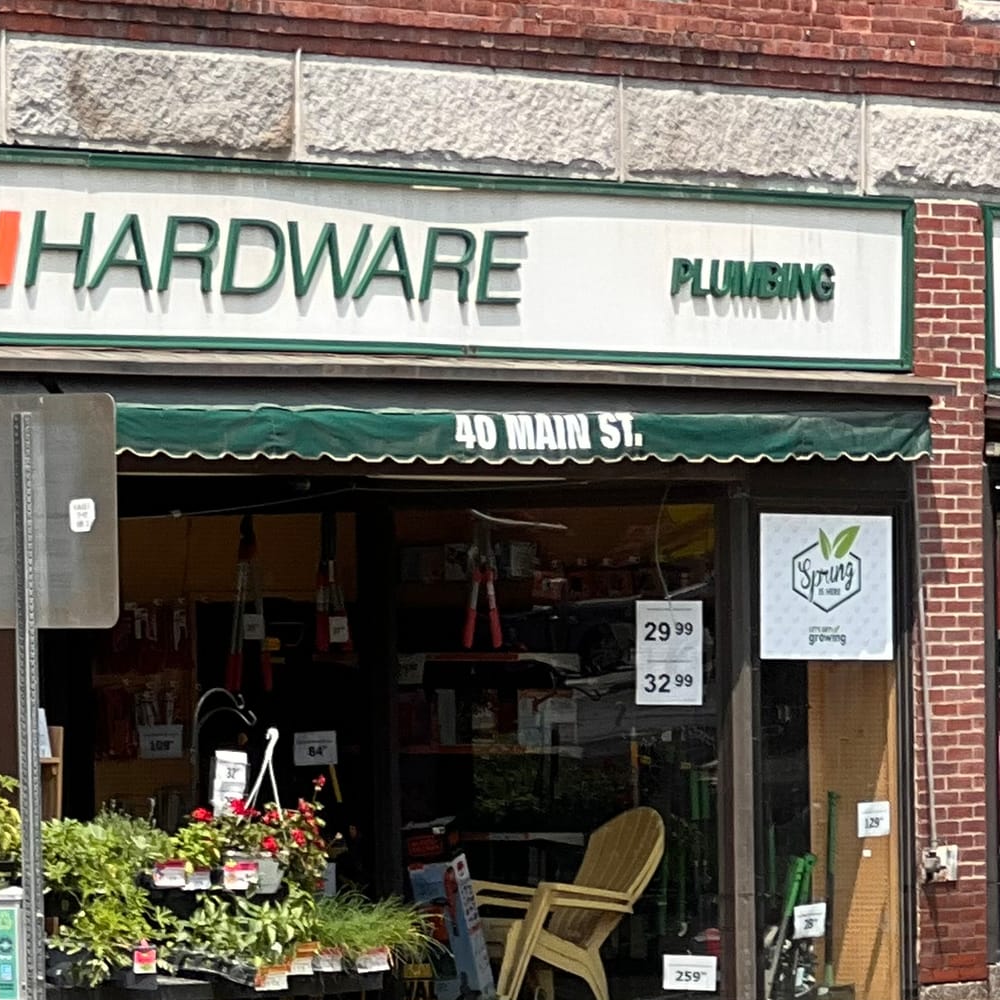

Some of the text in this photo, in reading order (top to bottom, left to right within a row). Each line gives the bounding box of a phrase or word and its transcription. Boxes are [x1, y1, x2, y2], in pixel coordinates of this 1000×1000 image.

[25, 210, 529, 305] HARDWARE
[670, 257, 835, 301] PLUMBING
[455, 412, 644, 450] 40 MAIN ST.
[797, 558, 854, 602] Spring
[644, 622, 693, 641] 29 99
[808, 633, 847, 646] growing
[644, 673, 693, 693] 32 99
[675, 970, 701, 982] 259
